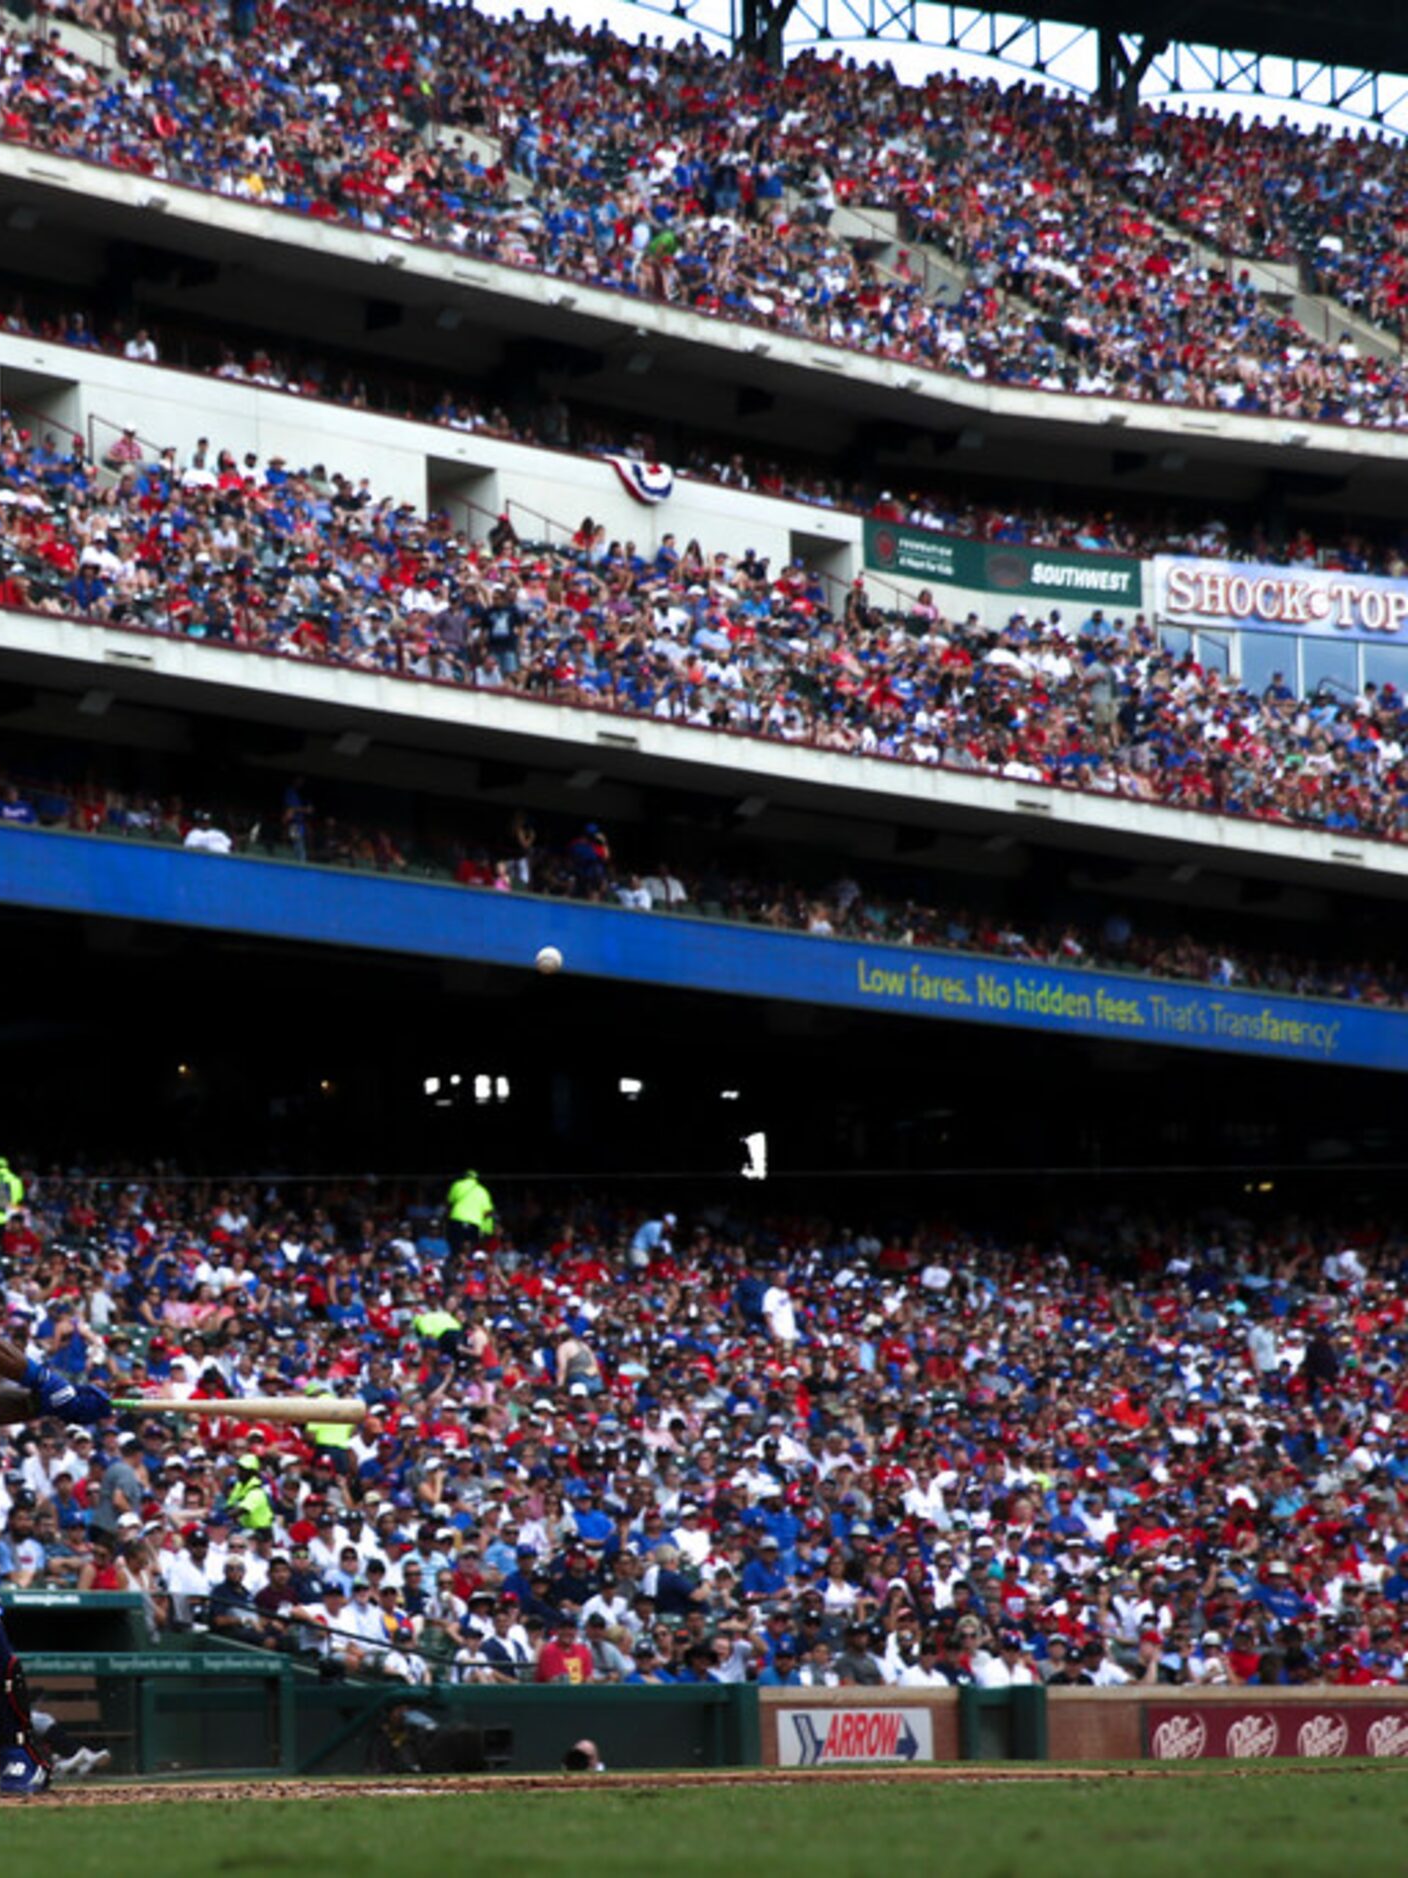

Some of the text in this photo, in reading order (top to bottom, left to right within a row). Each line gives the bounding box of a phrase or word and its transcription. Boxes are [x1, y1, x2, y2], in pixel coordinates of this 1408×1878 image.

[1031, 562, 1131, 593] SOUTHWEST
[1167, 567, 1408, 632] SHOCK TOP
[857, 959, 905, 996] Low
[910, 964, 972, 1005] fares.
[976, 974, 1011, 1009] No
[1014, 977, 1090, 1019] hidden
[1095, 986, 1145, 1025] fees.
[822, 1712, 905, 1758] ARROW
